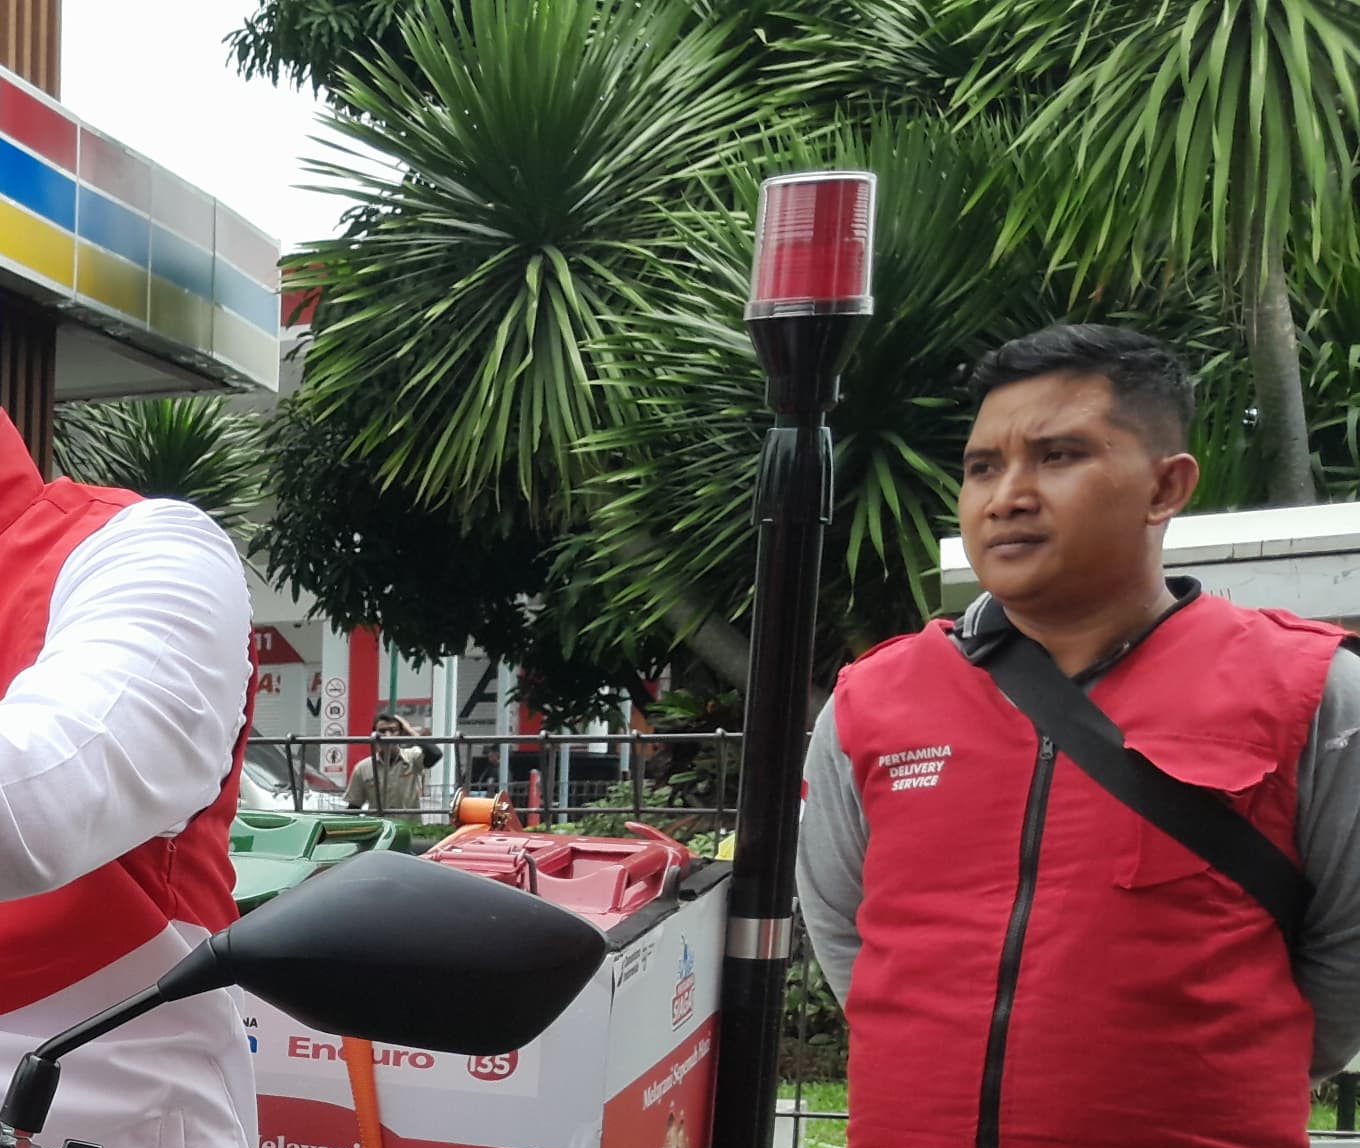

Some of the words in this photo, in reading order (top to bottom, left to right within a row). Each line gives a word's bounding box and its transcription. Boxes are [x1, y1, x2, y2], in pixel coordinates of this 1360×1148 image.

[878, 745, 952, 767] PERTAMINA
[889, 760, 945, 777] DELIVERY
[891, 775, 939, 792] SERVICE
